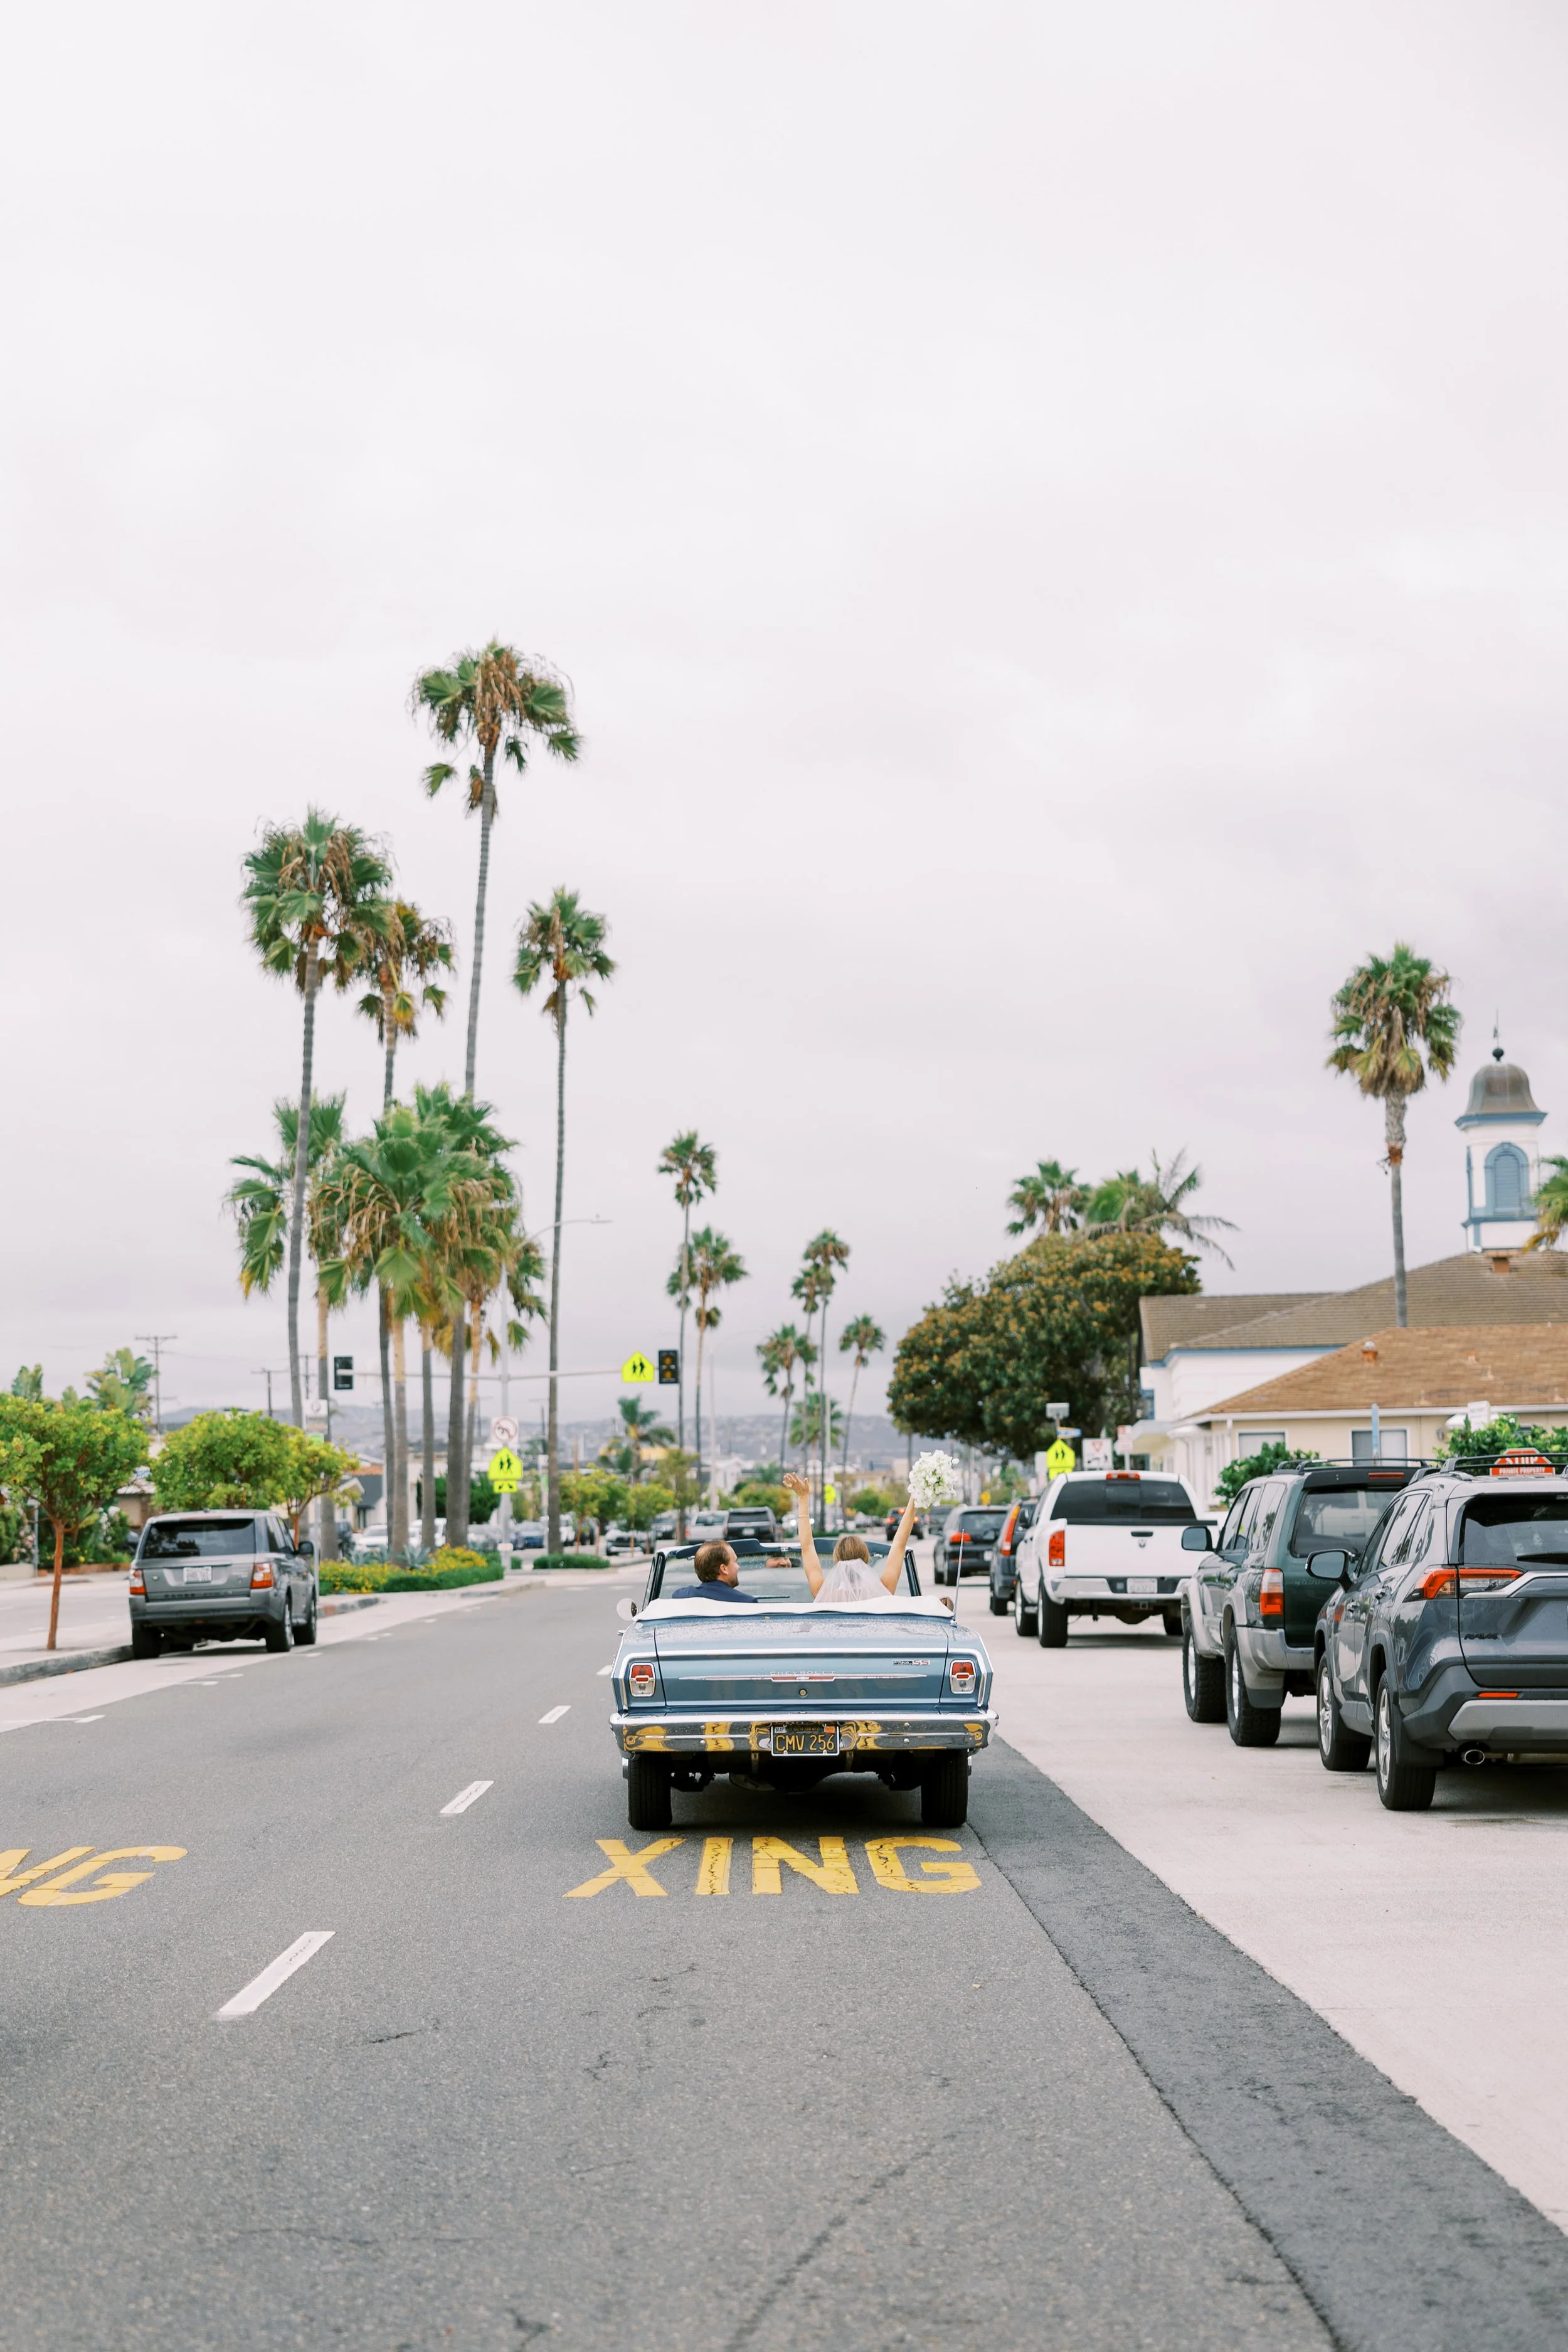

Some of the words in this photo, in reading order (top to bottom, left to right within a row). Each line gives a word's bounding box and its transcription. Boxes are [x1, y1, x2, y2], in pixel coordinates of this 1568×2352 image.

[776, 1734, 805, 1751] CMV
[810, 1734, 834, 1751] 256
[563, 1836, 983, 1897] XING
